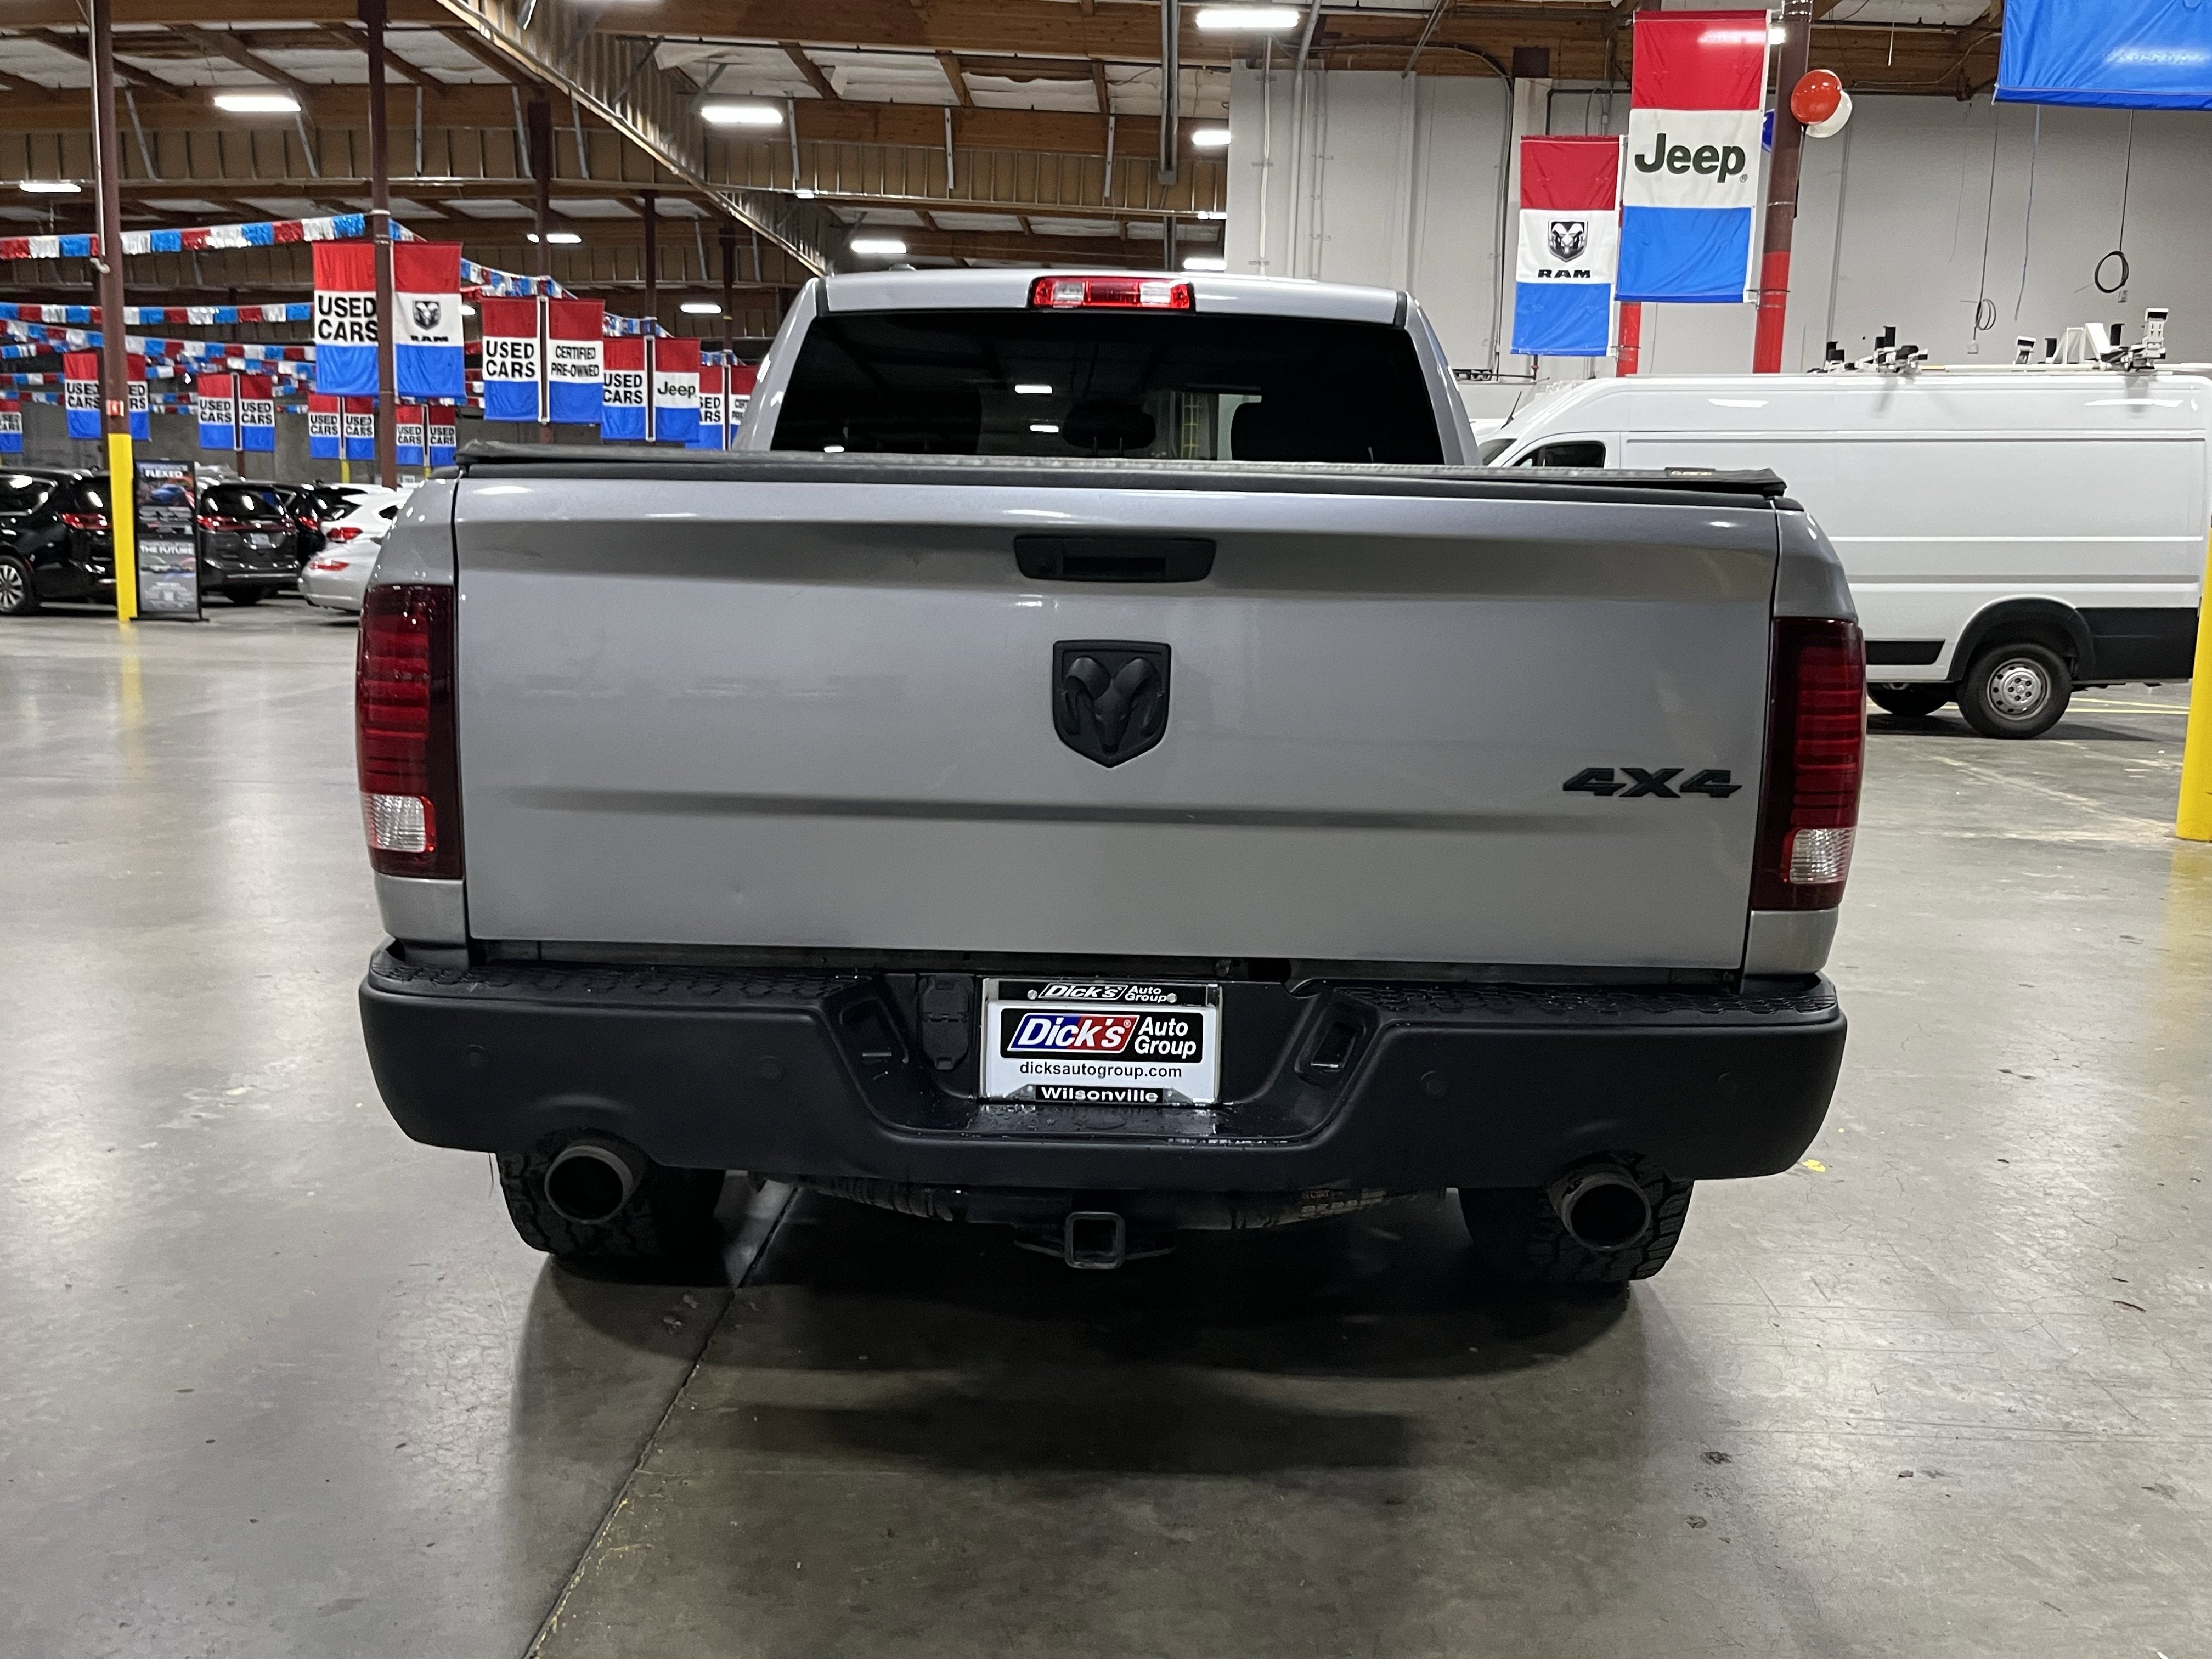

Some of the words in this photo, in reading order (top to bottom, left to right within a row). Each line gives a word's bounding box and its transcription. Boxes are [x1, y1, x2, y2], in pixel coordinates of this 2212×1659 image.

[1634, 133, 1746, 183] Jeep
[1538, 269, 1591, 278] RAM
[318, 295, 377, 318] USED
[318, 319, 377, 342] CARS
[486, 340, 534, 359] USED
[555, 345, 596, 360] CERTIFIED
[486, 360, 535, 378] CARS
[551, 362, 600, 377] PRE-OWNED
[604, 374, 643, 388] USED
[129, 385, 146, 396] ED
[657, 382, 696, 398] Jeep
[604, 389, 644, 404] CARS
[129, 397, 146, 409] RS
[200, 400, 231, 410] USED
[241, 402, 271, 412] USED
[200, 411, 232, 422] CARS
[241, 414, 273, 425] CARS
[311, 415, 338, 425] USED
[346, 415, 373, 426] USED
[311, 425, 338, 435] CARS
[346, 426, 373, 436] CARS
[398, 426, 422, 435] USED
[430, 427, 455, 436] USED
[398, 436, 422, 444] CARS
[430, 437, 455, 445] CARS
[1045, 985, 1118, 998] Dick's
[1127, 986, 1161, 995] Auto
[1124, 992, 1167, 1003] Group
[1017, 1017, 1126, 1048] Dick's
[1138, 1017, 1188, 1036] Auto
[1135, 1036, 1197, 1059] Group
[1020, 1062, 1182, 1079] dicksautogroup.com
[1041, 1087, 1159, 1102] Wilsonville
